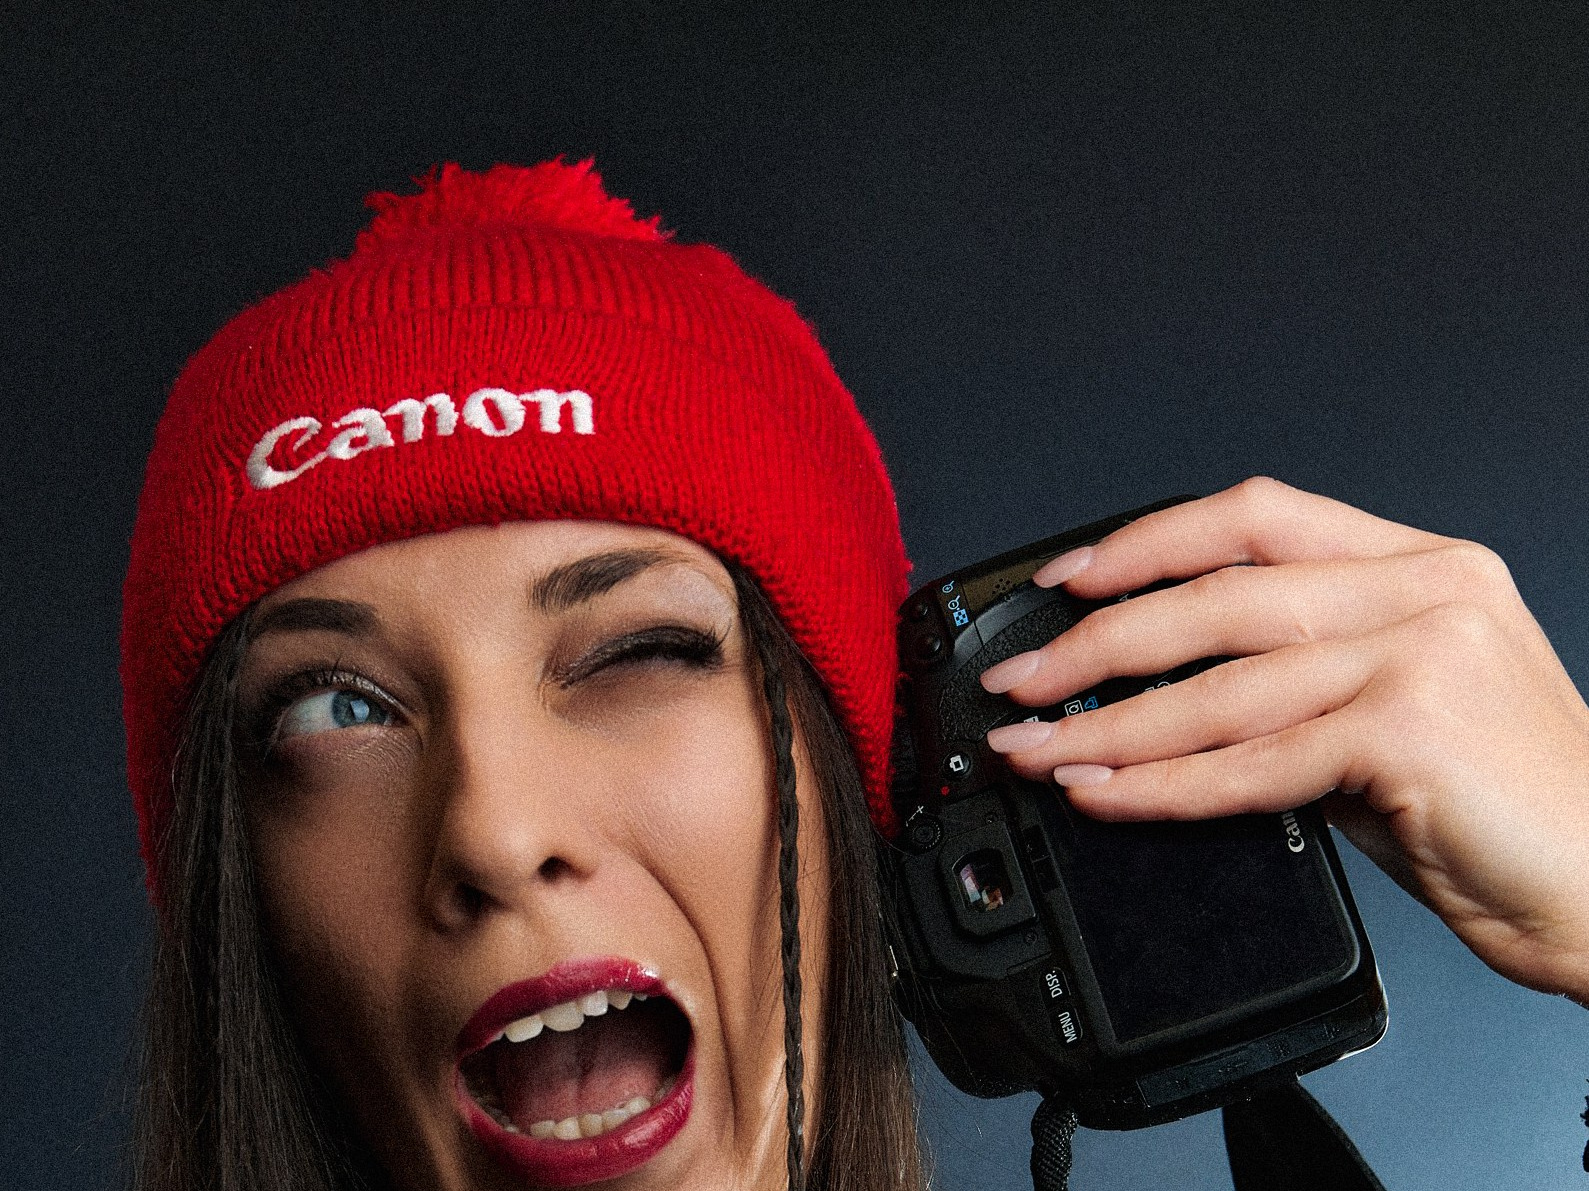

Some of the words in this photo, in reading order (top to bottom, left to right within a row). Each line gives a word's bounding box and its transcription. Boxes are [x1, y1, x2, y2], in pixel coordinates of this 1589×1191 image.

[246, 388, 595, 489] Canon
[1281, 811, 1305, 853] Can
[1058, 1011, 1078, 1043] MENU
